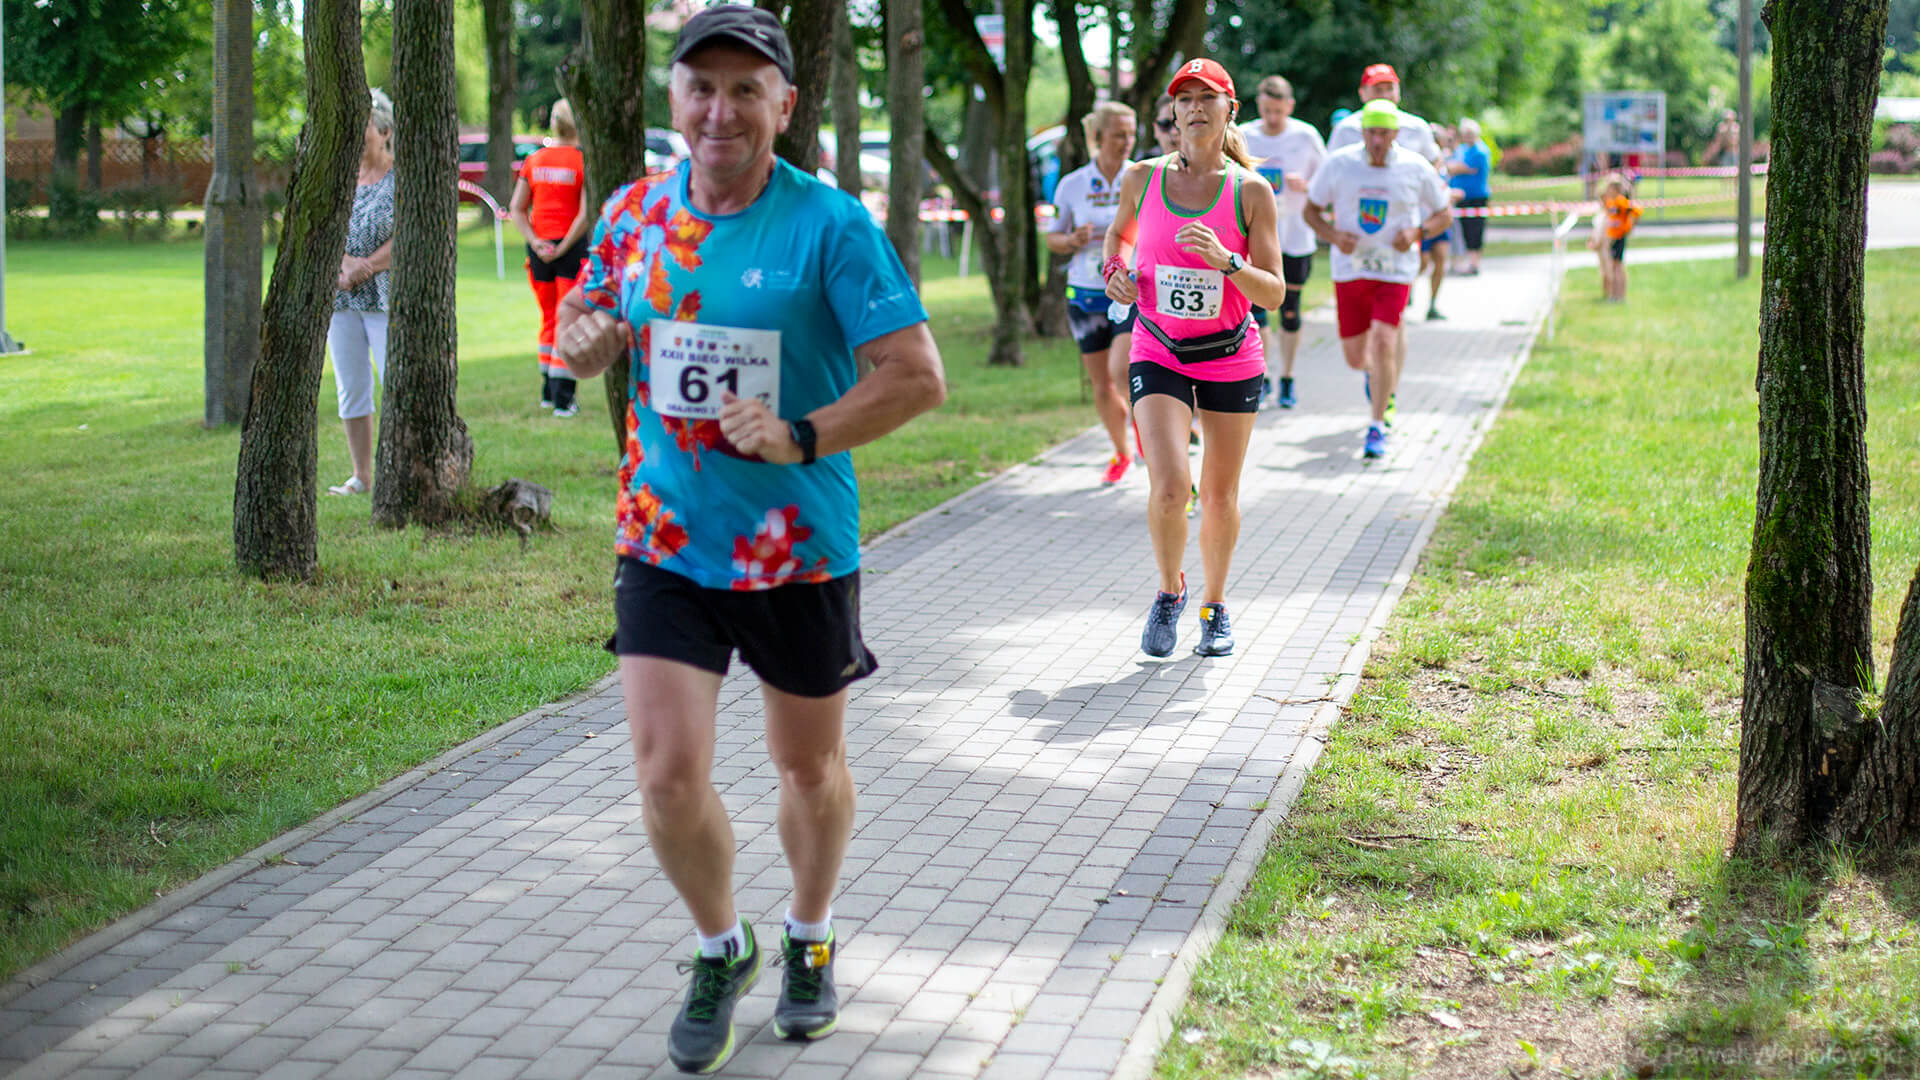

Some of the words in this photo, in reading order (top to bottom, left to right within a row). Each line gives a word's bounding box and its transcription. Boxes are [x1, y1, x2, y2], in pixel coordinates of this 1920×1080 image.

[1170, 289, 1204, 312] 63
[659, 348, 684, 361] XXII
[687, 352, 720, 365] BIEG
[723, 355, 769, 367] WILKA
[679, 366, 738, 404] 61
